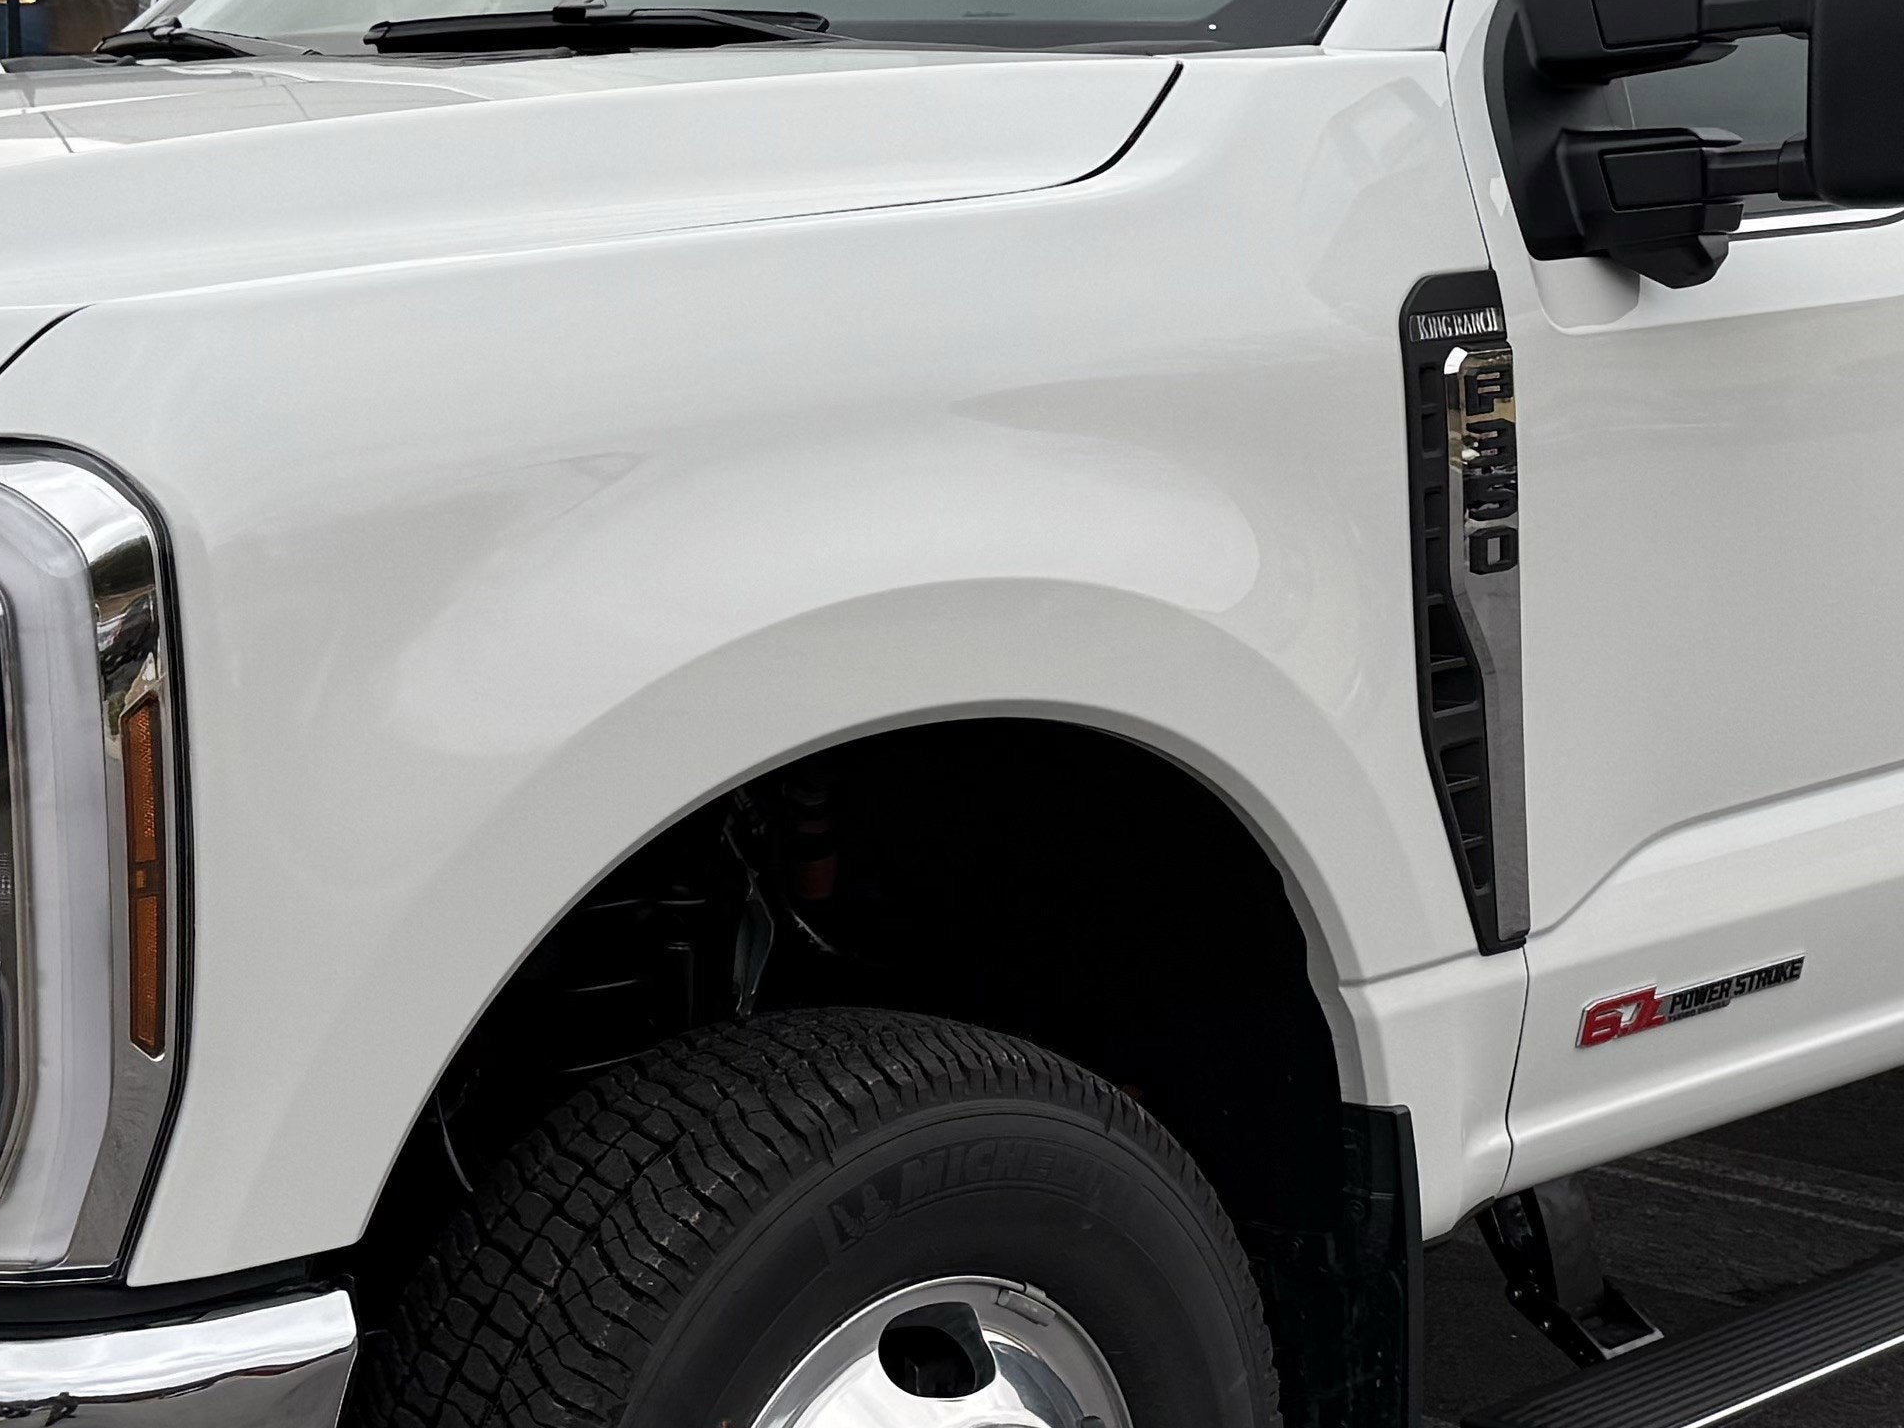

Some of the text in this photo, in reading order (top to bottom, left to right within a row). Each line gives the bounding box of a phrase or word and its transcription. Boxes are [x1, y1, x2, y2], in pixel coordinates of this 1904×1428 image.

[1416, 315, 1453, 340] KING
[1669, 980, 1731, 1013] POWER
[1734, 956, 1804, 996] STROKE
